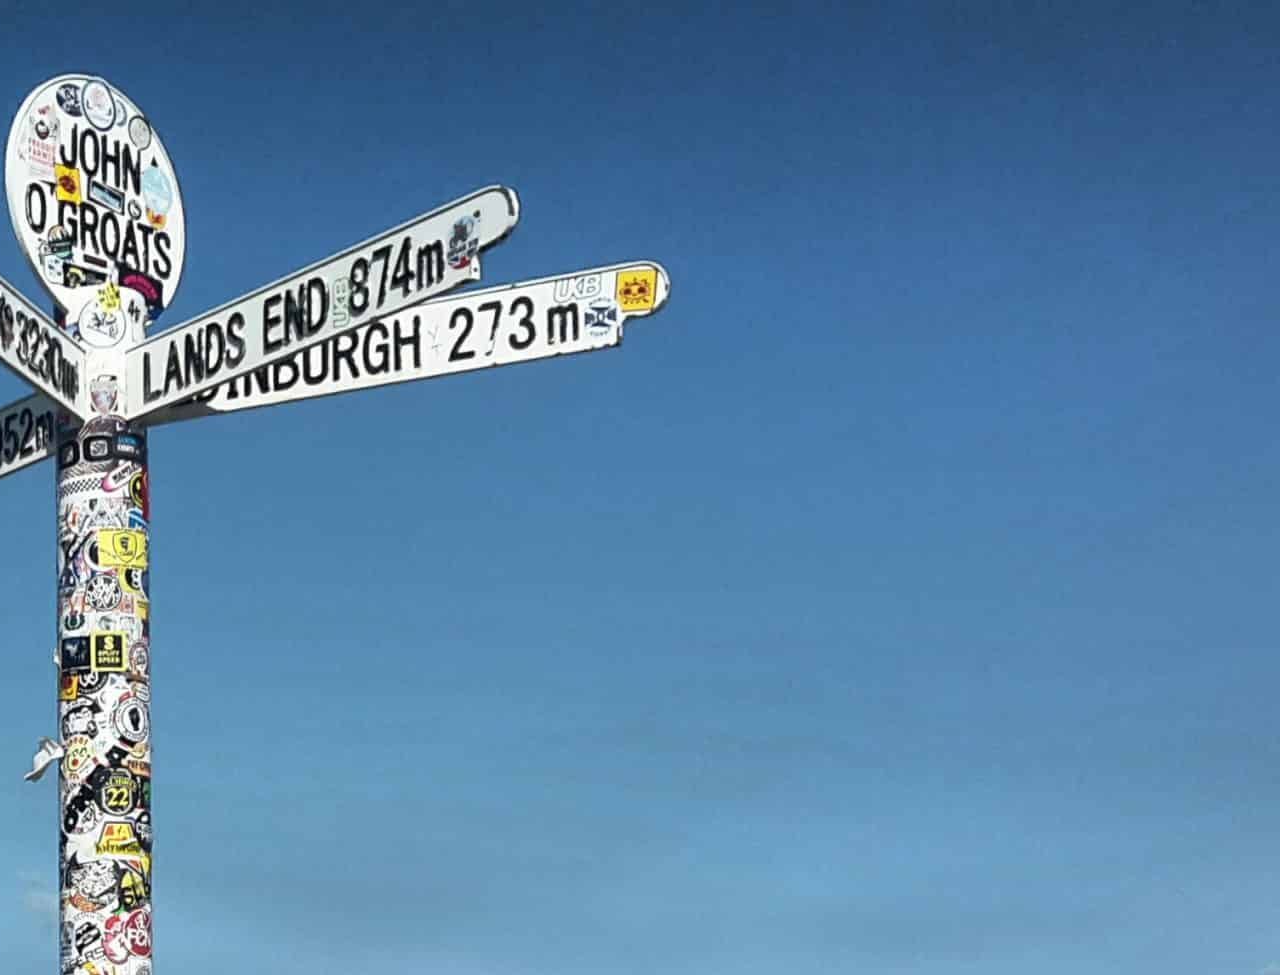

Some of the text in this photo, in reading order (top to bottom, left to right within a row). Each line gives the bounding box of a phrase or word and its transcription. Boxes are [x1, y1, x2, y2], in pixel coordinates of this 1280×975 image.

[59, 122, 141, 196] JOHN
[142, 311, 246, 404] LANDS
[262, 276, 330, 356] END
